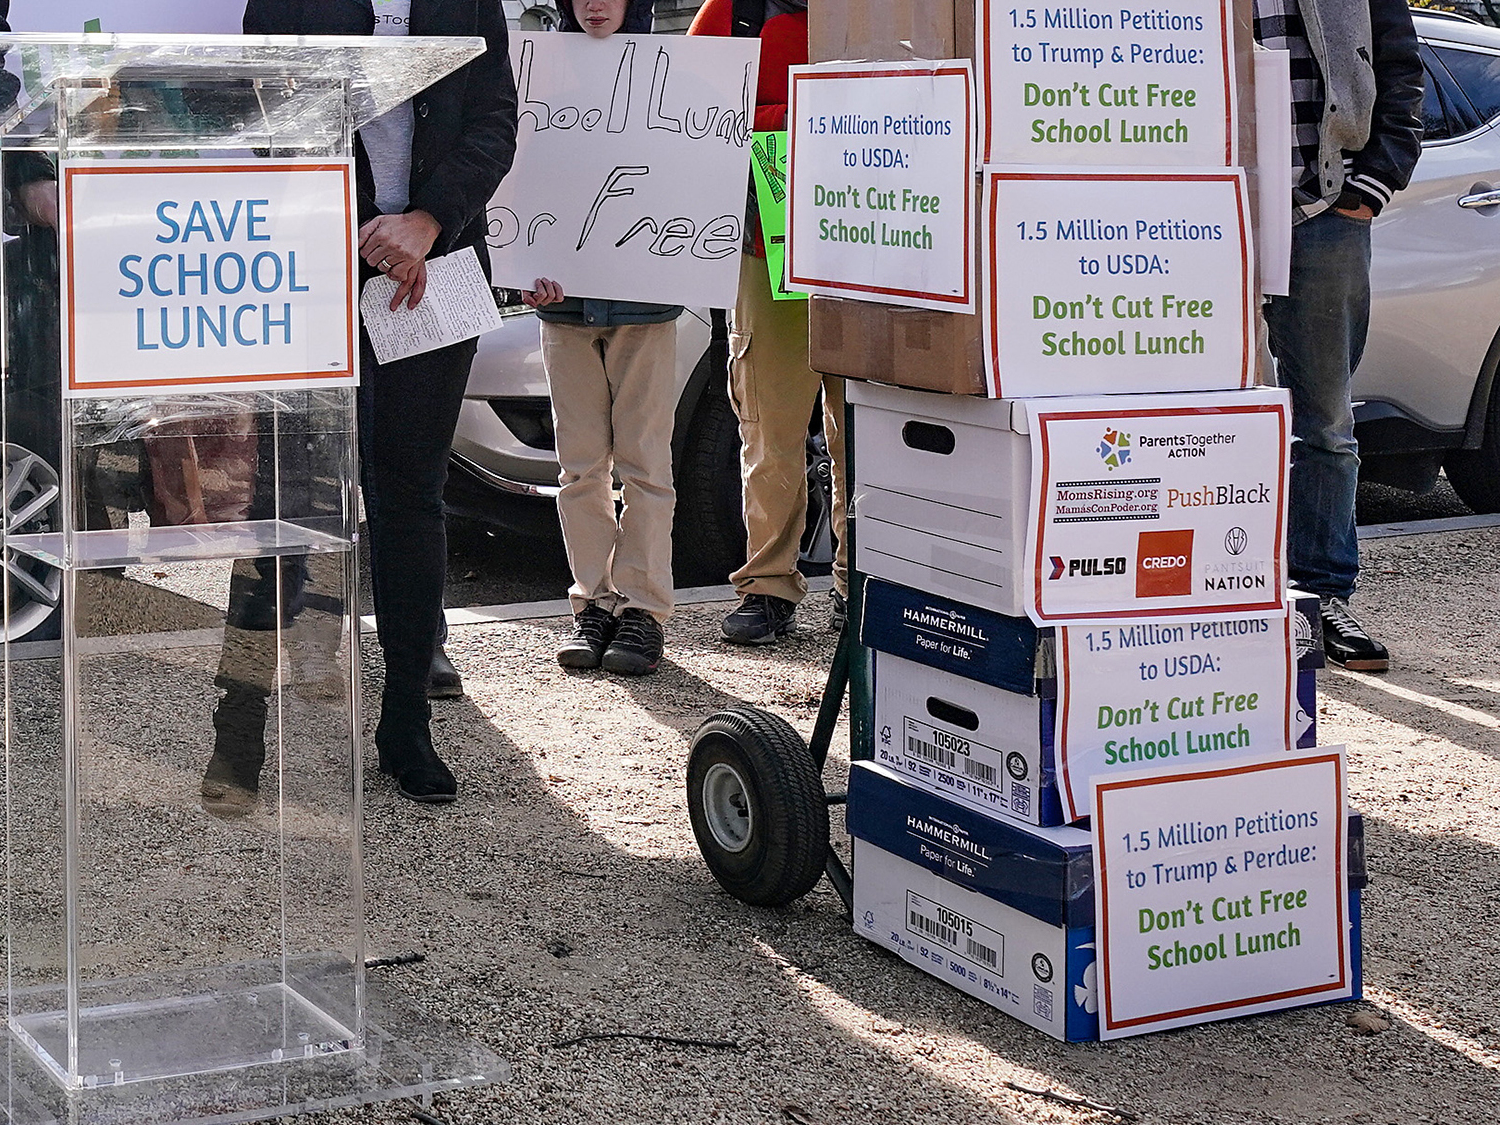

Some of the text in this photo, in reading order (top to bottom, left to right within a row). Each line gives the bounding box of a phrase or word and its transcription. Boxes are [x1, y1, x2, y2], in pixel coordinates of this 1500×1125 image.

[1009, 8, 1204, 32] 1.5 Million Petitions
[1012, 43, 1204, 68] to Trump & Perdue:
[517, 39, 636, 133] hool
[1024, 83, 1196, 108] Don't Cut Free
[808, 115, 951, 137] 1.5 Million Petitions
[1031, 119, 1188, 143] School Lunch
[843, 149, 909, 169] to USDA:
[485, 206, 557, 249] or
[576, 166, 740, 259] Free
[814, 185, 940, 214] Don't Cut Free
[156, 199, 271, 243] SAVE
[1017, 220, 1222, 241] 1.5 Million Petitions
[819, 219, 933, 250] School Lunch
[119, 251, 309, 298] SCHOOL
[1079, 255, 1169, 275] to USDA:
[1032, 295, 1213, 320] Don't Cut Free
[136, 303, 292, 351] LUNCH
[1042, 330, 1204, 357] School Lunch
[1139, 433, 1236, 448] ParentsTogether
[1168, 447, 1206, 458] ACTION
[1057, 488, 1159, 502] MomsRising.org
[1167, 483, 1271, 508] PushBlack
[1056, 503, 1158, 515] MamásConPoder.org
[1069, 557, 1126, 577] PULSO
[1142, 557, 1186, 569] CREDO
[1205, 561, 1265, 574] PANTSUIT
[1205, 575, 1265, 591] NATION
[903, 608, 987, 641] HAMMERMILL
[916, 635, 938, 650] Paper
[940, 641, 952, 654] for
[1085, 630, 1112, 652] 1.5
[1120, 624, 1184, 649] Million
[1139, 653, 1221, 681] to USDA:
[1097, 691, 1259, 729] Don't Cut Free
[932, 730, 971, 757] 105023
[1104, 723, 1250, 765] School Lunch
[880, 749, 889, 760] 20
[938, 771, 955, 786] 2500
[907, 815, 989, 859] HAMMERMILL
[1122, 810, 1318, 853] 1.5 Million Petitions
[920, 844, 943, 862] Paper
[944, 854, 957, 868] for
[1126, 845, 1316, 889] to Trump & Perdue:
[936, 907, 973, 936] 105015
[1138, 888, 1307, 933] Don't Cut Free
[1147, 922, 1301, 970] School Lunch
[949, 961, 966, 977] 5000
